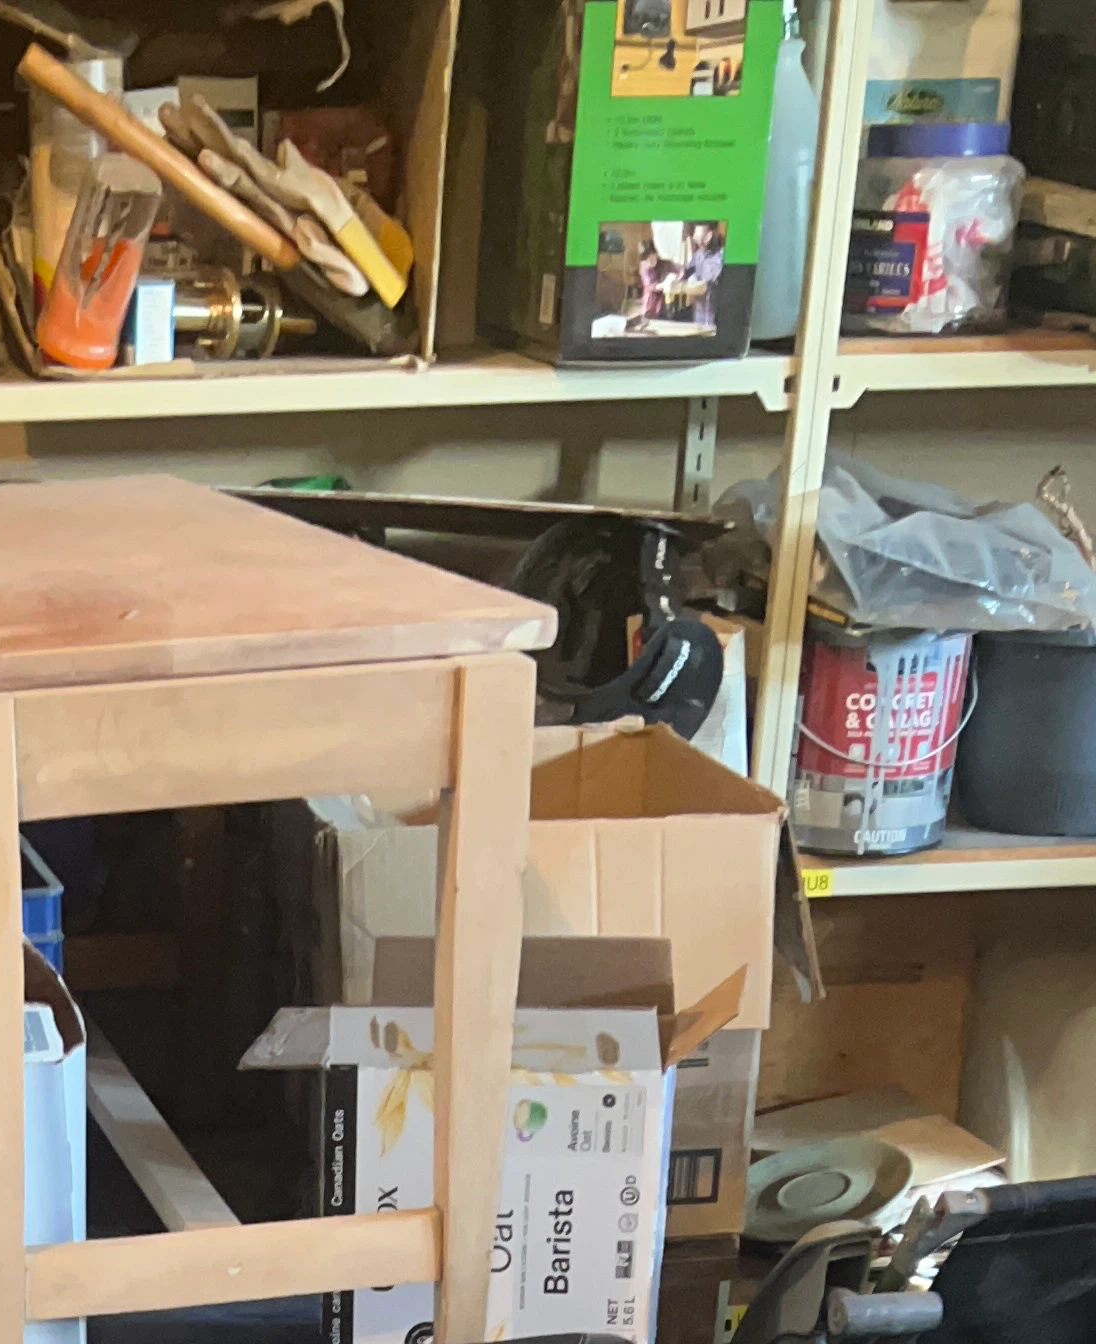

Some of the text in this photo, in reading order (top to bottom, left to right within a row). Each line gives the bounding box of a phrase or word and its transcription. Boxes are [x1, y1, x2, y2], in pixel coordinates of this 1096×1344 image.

[332, 1108, 345, 1141] Oats
[331, 1144, 344, 1207] Canadian
[543, 1189, 575, 1295] Barista
[606, 1297, 619, 1326] NET
